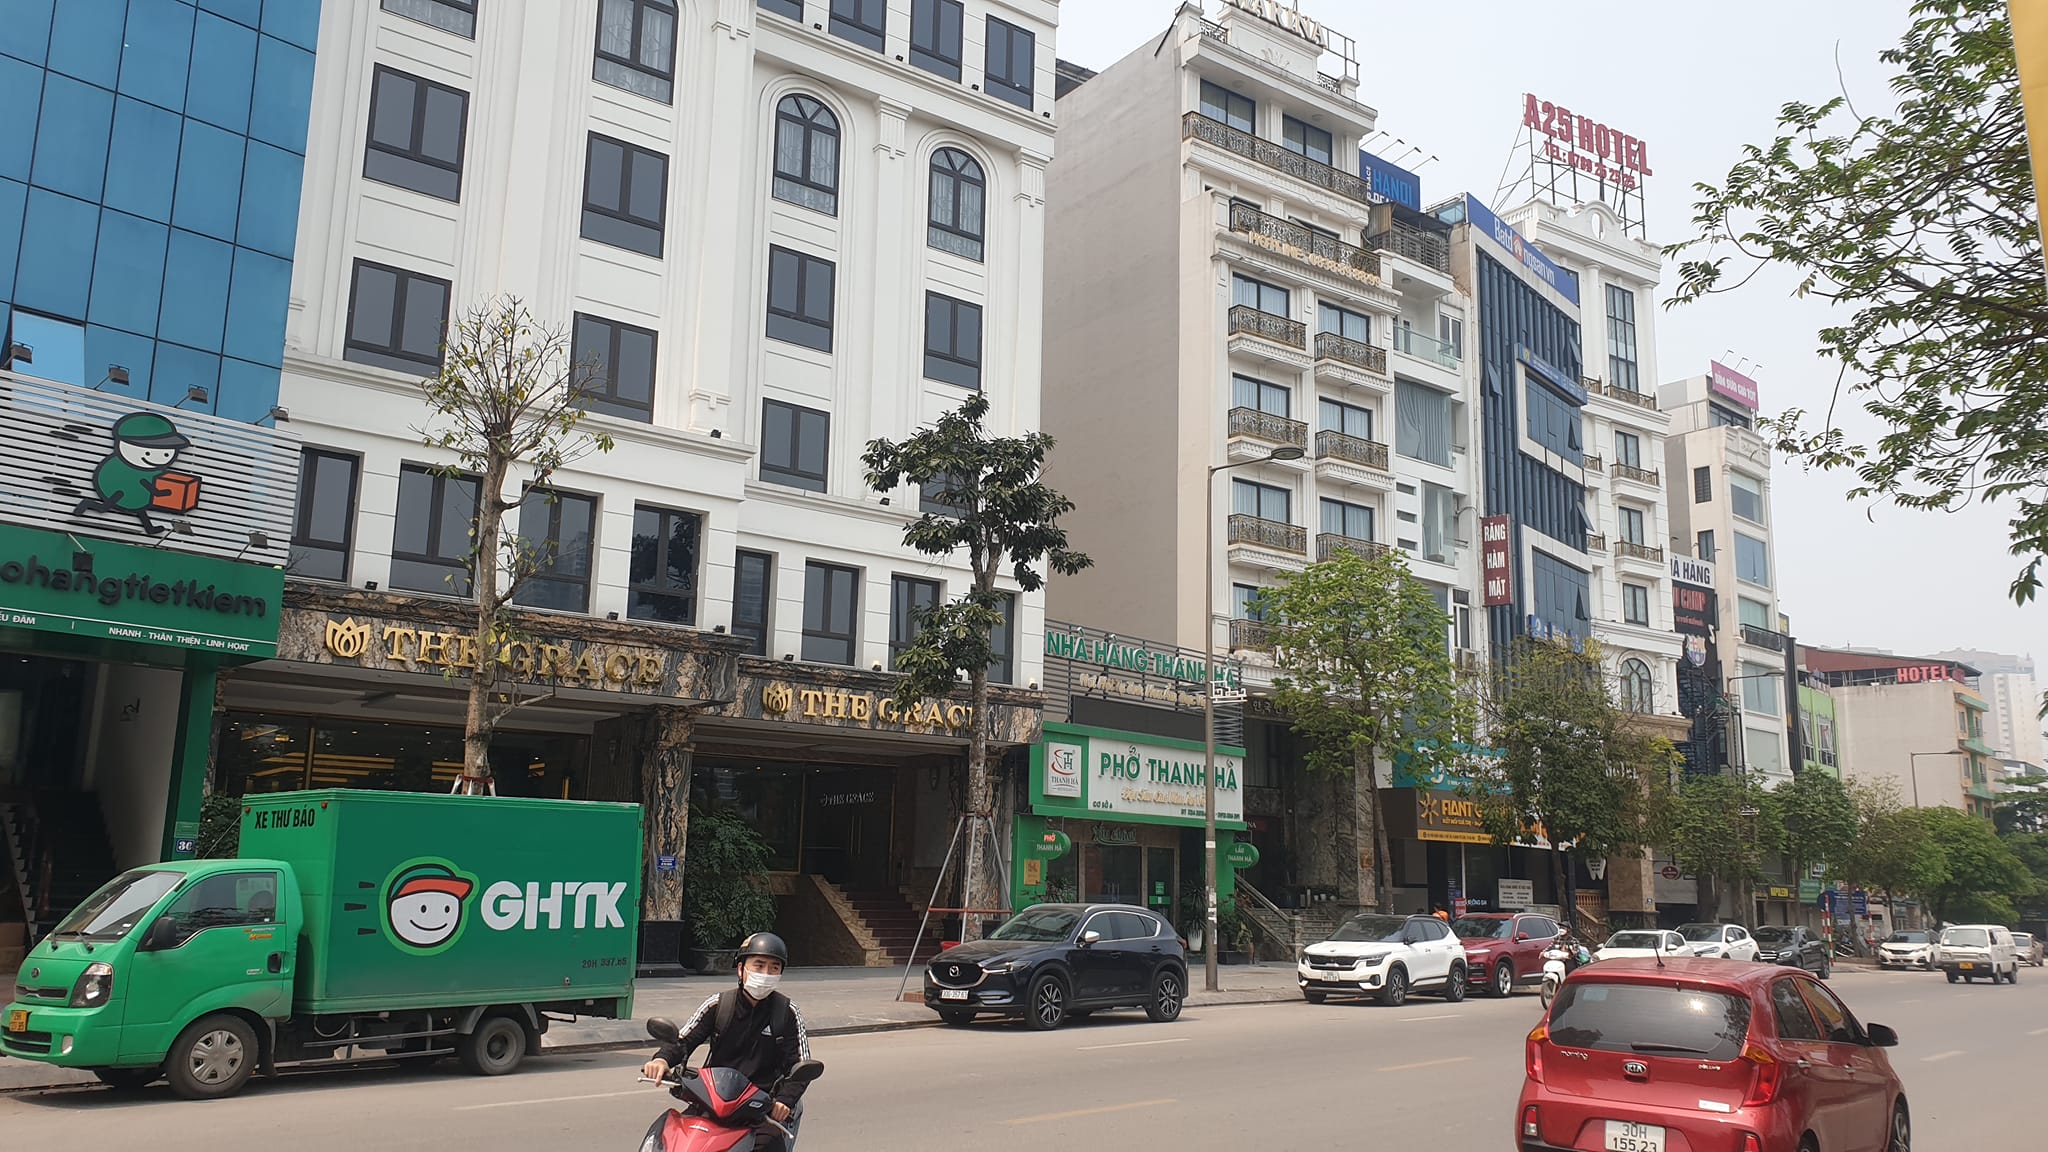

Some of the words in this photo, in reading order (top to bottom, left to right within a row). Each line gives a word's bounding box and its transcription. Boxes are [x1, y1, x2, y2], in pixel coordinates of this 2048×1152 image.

[1524, 93, 1573, 143] A25
[1577, 114, 1652, 176] HOTEL
[1484, 521, 1506, 542] RĂNG
[1683, 560, 1710, 585] HÀNG
[108, 627, 142, 638] NHANH
[206, 639, 225, 649] LINH
[383, 626, 480, 669] THE
[503, 641, 664, 685] GRACE
[1047, 627, 1088, 661] NHÀ
[1094, 634, 1148, 673] HÀNG
[1153, 652, 1206, 684] THANH
[1897, 664, 1951, 683] HOTEL
[800, 690, 871, 721] THE
[1146, 757, 1206, 786] THANH
[1215, 758, 1238, 790] HÀ
[255, 811, 268, 829] XE
[272, 808, 292, 828] THƯ
[293, 805, 315, 827] BÁO
[480, 881, 627, 931] GHTK
[1625, 1064, 1644, 1074] KIA
[1622, 1123, 1648, 1140] 30H
